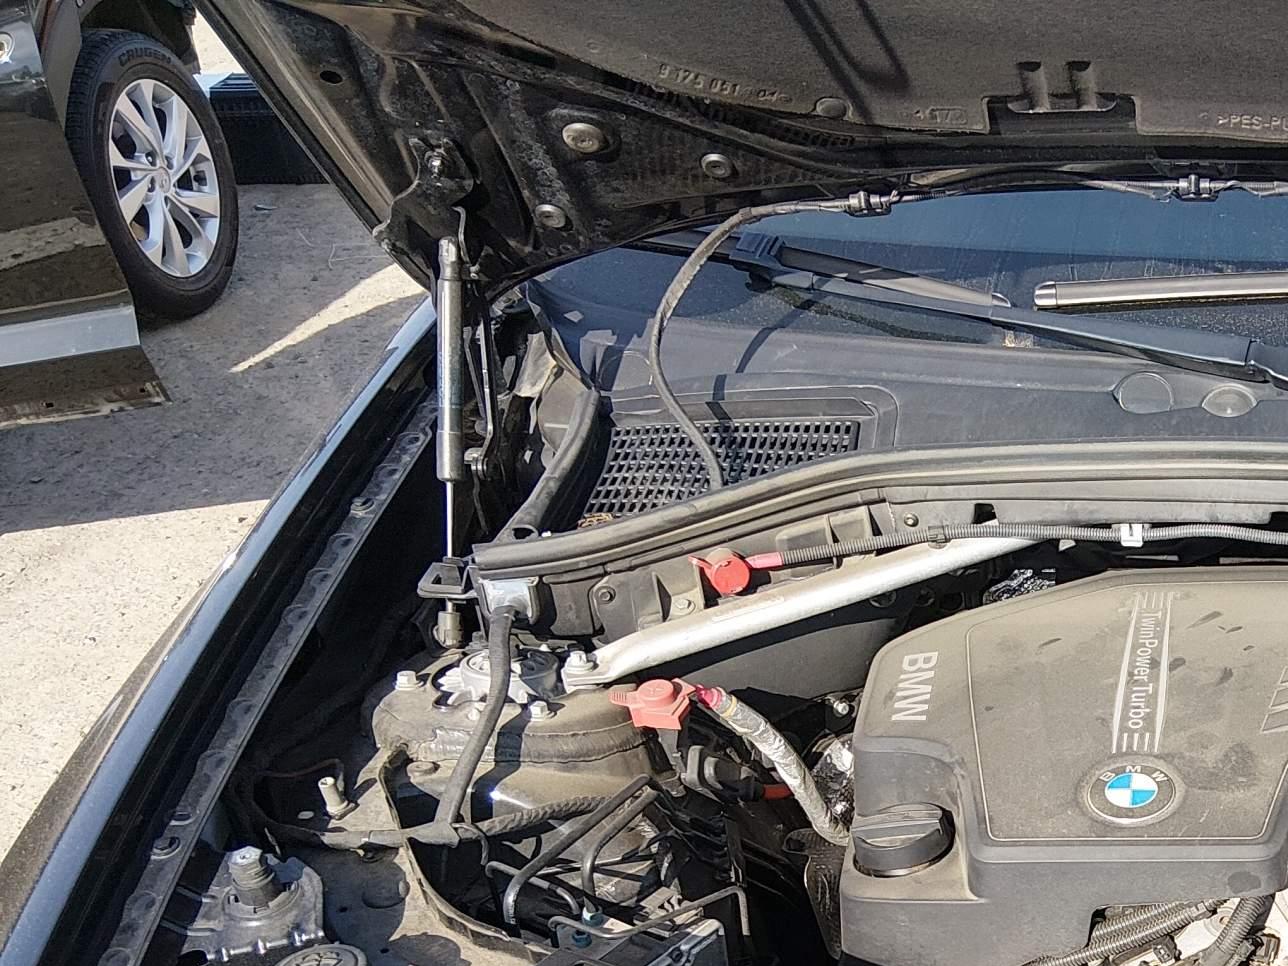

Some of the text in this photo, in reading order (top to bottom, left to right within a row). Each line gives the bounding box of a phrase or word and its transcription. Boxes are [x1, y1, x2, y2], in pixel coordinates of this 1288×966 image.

[891, 651, 939, 721] BMW
[1128, 683, 1153, 729] Turbo
[1099, 765, 1168, 782] BMW
